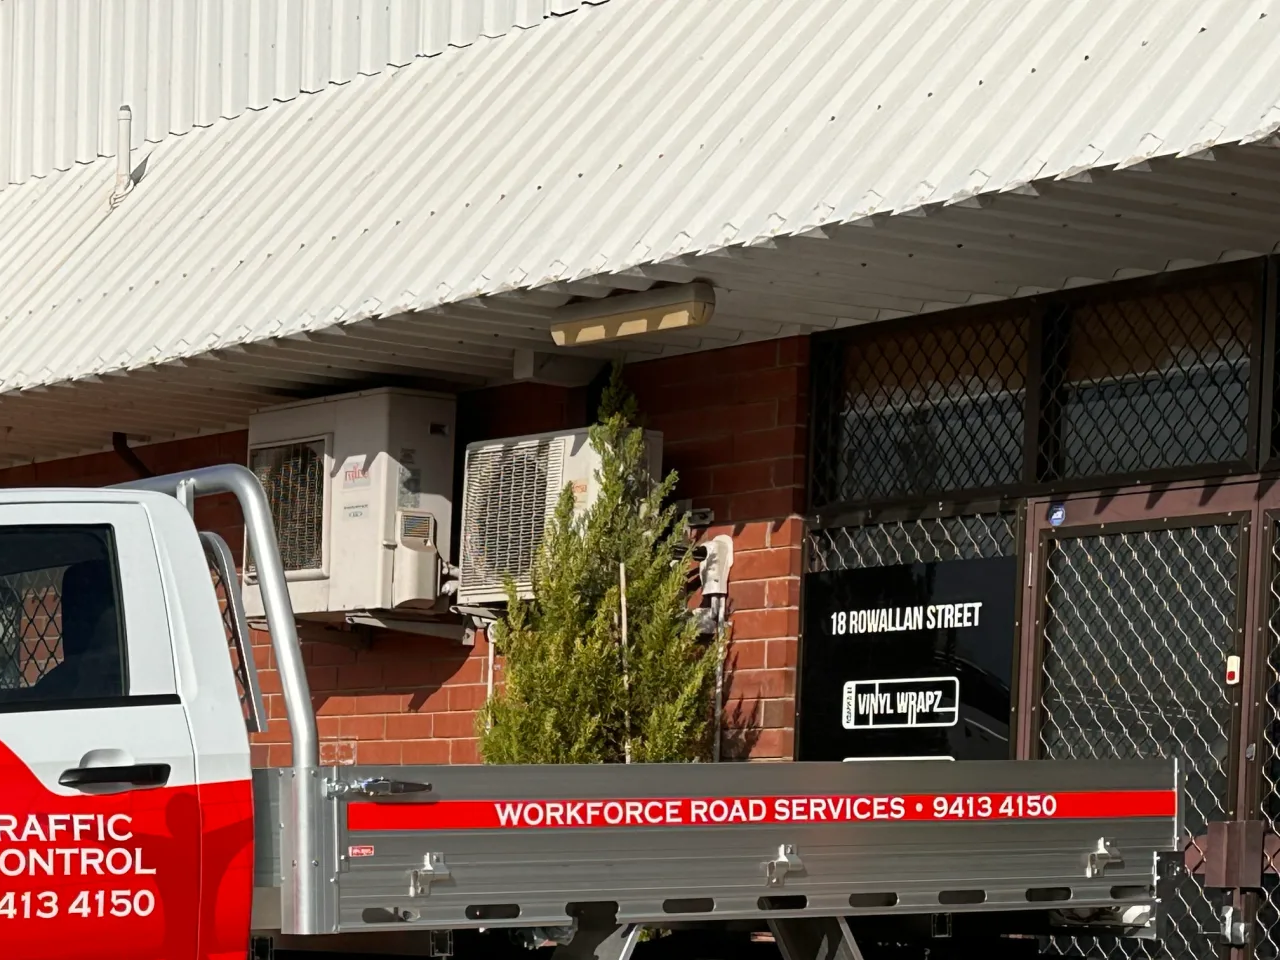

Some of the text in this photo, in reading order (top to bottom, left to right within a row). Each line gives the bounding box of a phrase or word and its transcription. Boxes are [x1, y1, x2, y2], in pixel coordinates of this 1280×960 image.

[830, 601, 983, 636] 18 ROWALLAN STREET
[857, 691, 894, 716] VINYL
[896, 689, 946, 715] WRAPZ
[494, 794, 1057, 827] WORKFORCE ROAD SERVICES 9413 4150
[67, 889, 155, 918] 4150
